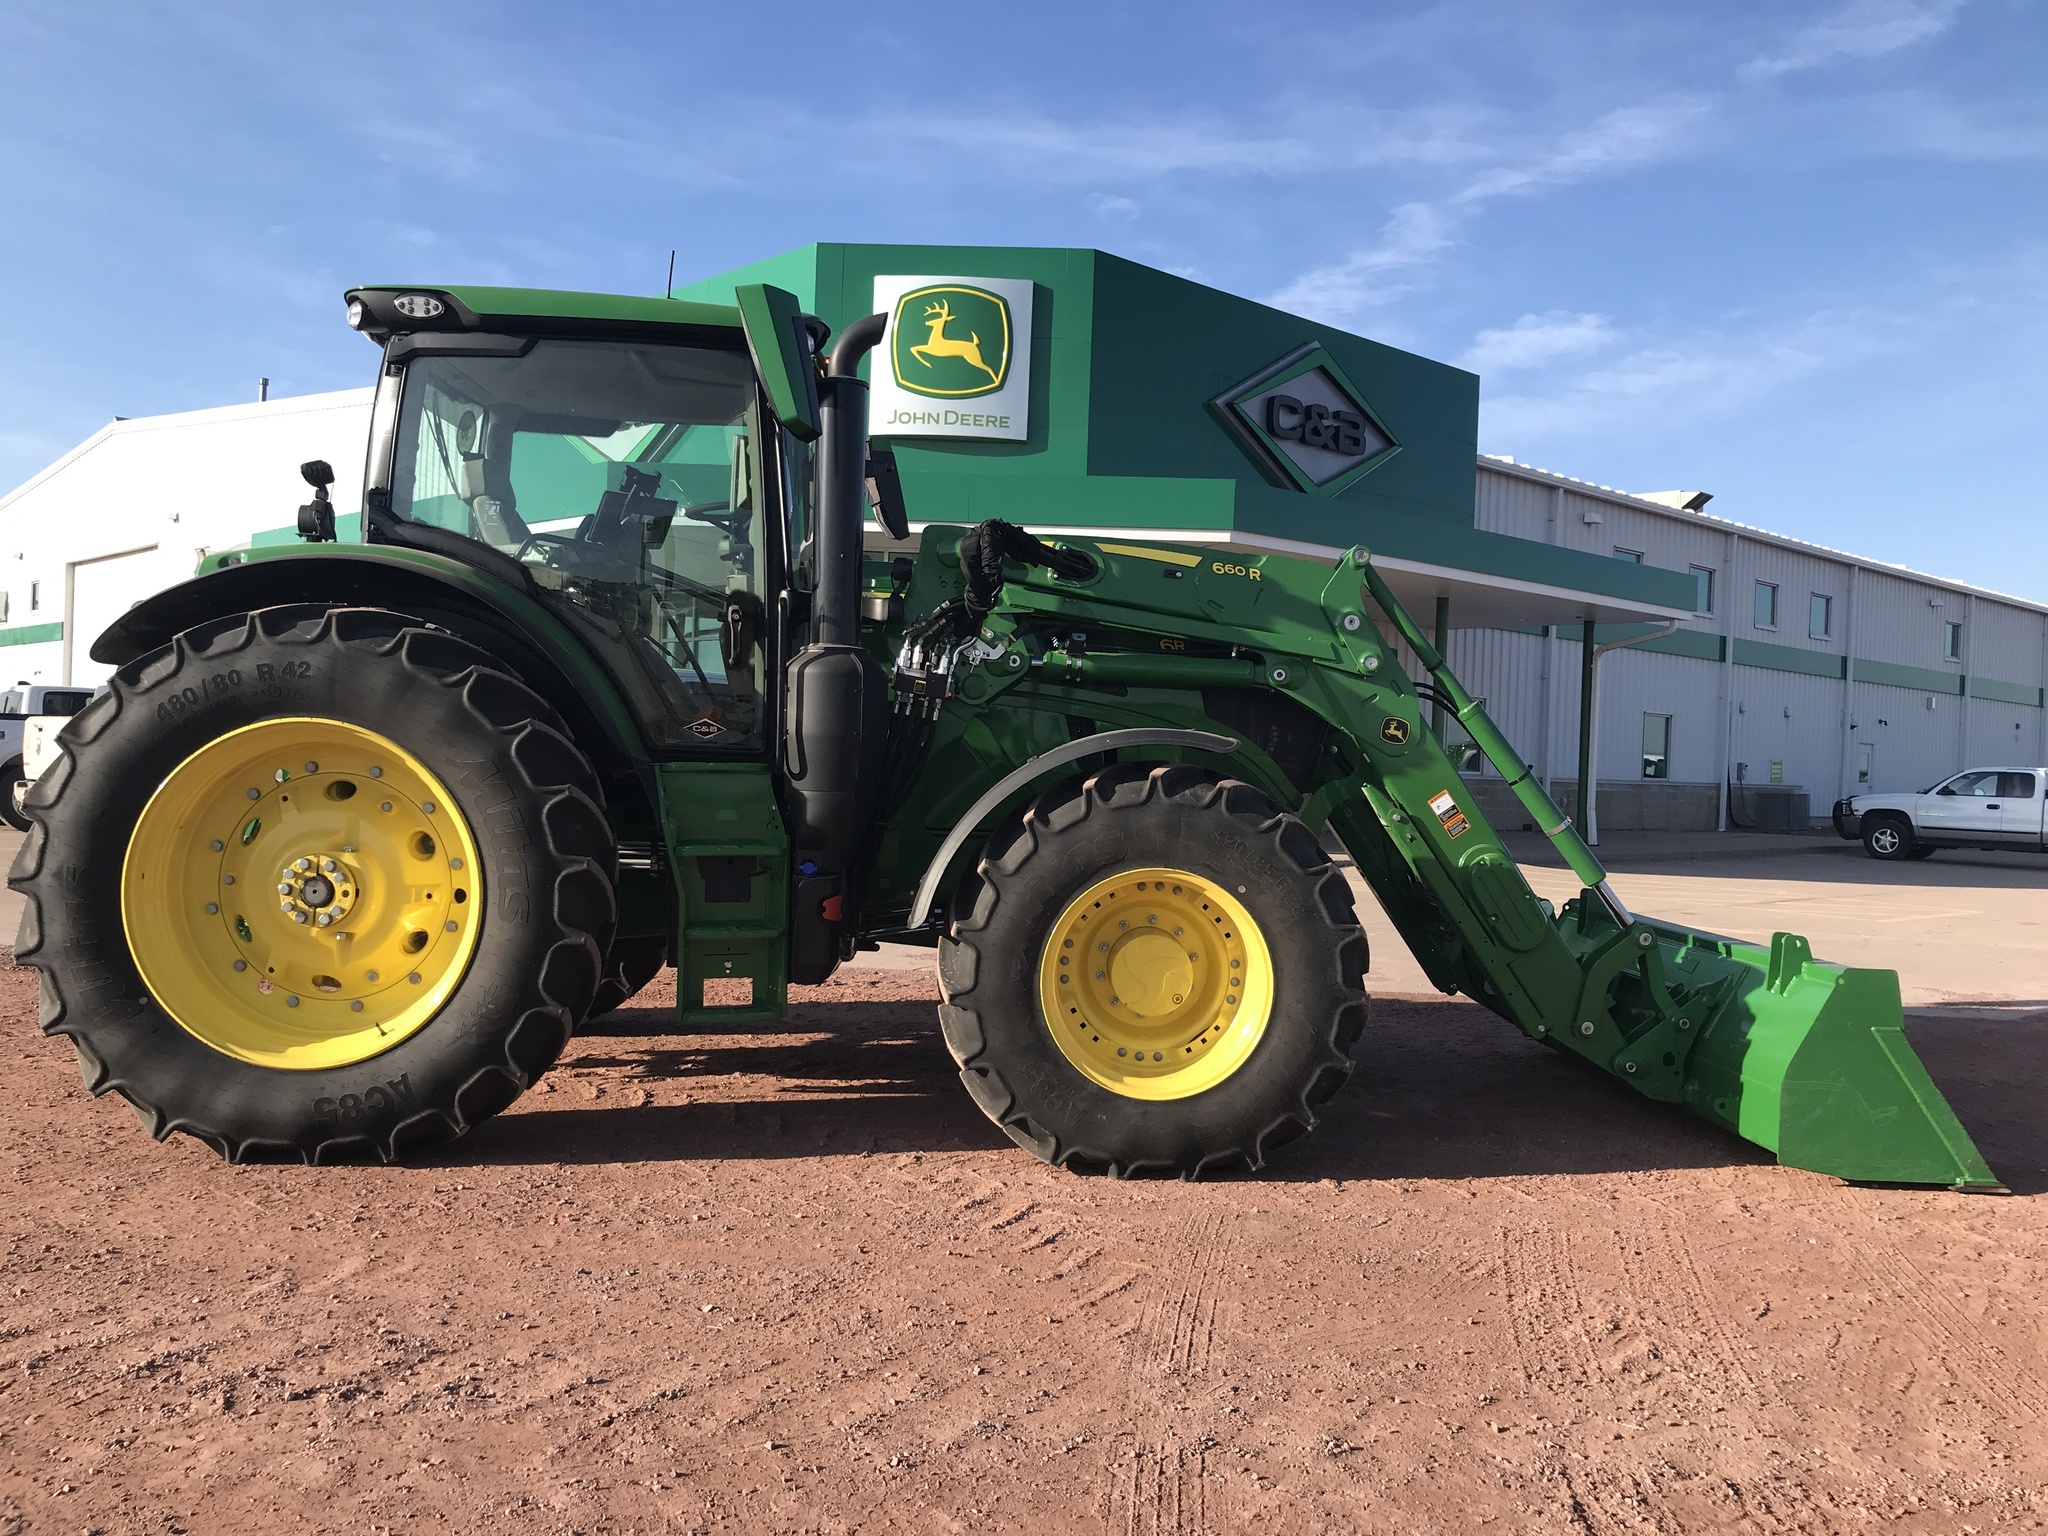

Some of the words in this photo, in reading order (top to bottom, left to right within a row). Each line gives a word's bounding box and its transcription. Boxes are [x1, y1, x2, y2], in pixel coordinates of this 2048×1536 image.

[887, 409, 940, 425] JOHN
[943, 410, 1011, 428] DEERE
[1266, 394, 1366, 456] C&B
[1212, 562, 1246, 576] 660
[1248, 567, 1262, 582] R
[1160, 638, 1185, 651] 6R
[156, 669, 243, 722] 480/80
[256, 662, 276, 682] R
[281, 660, 312, 680] 42
